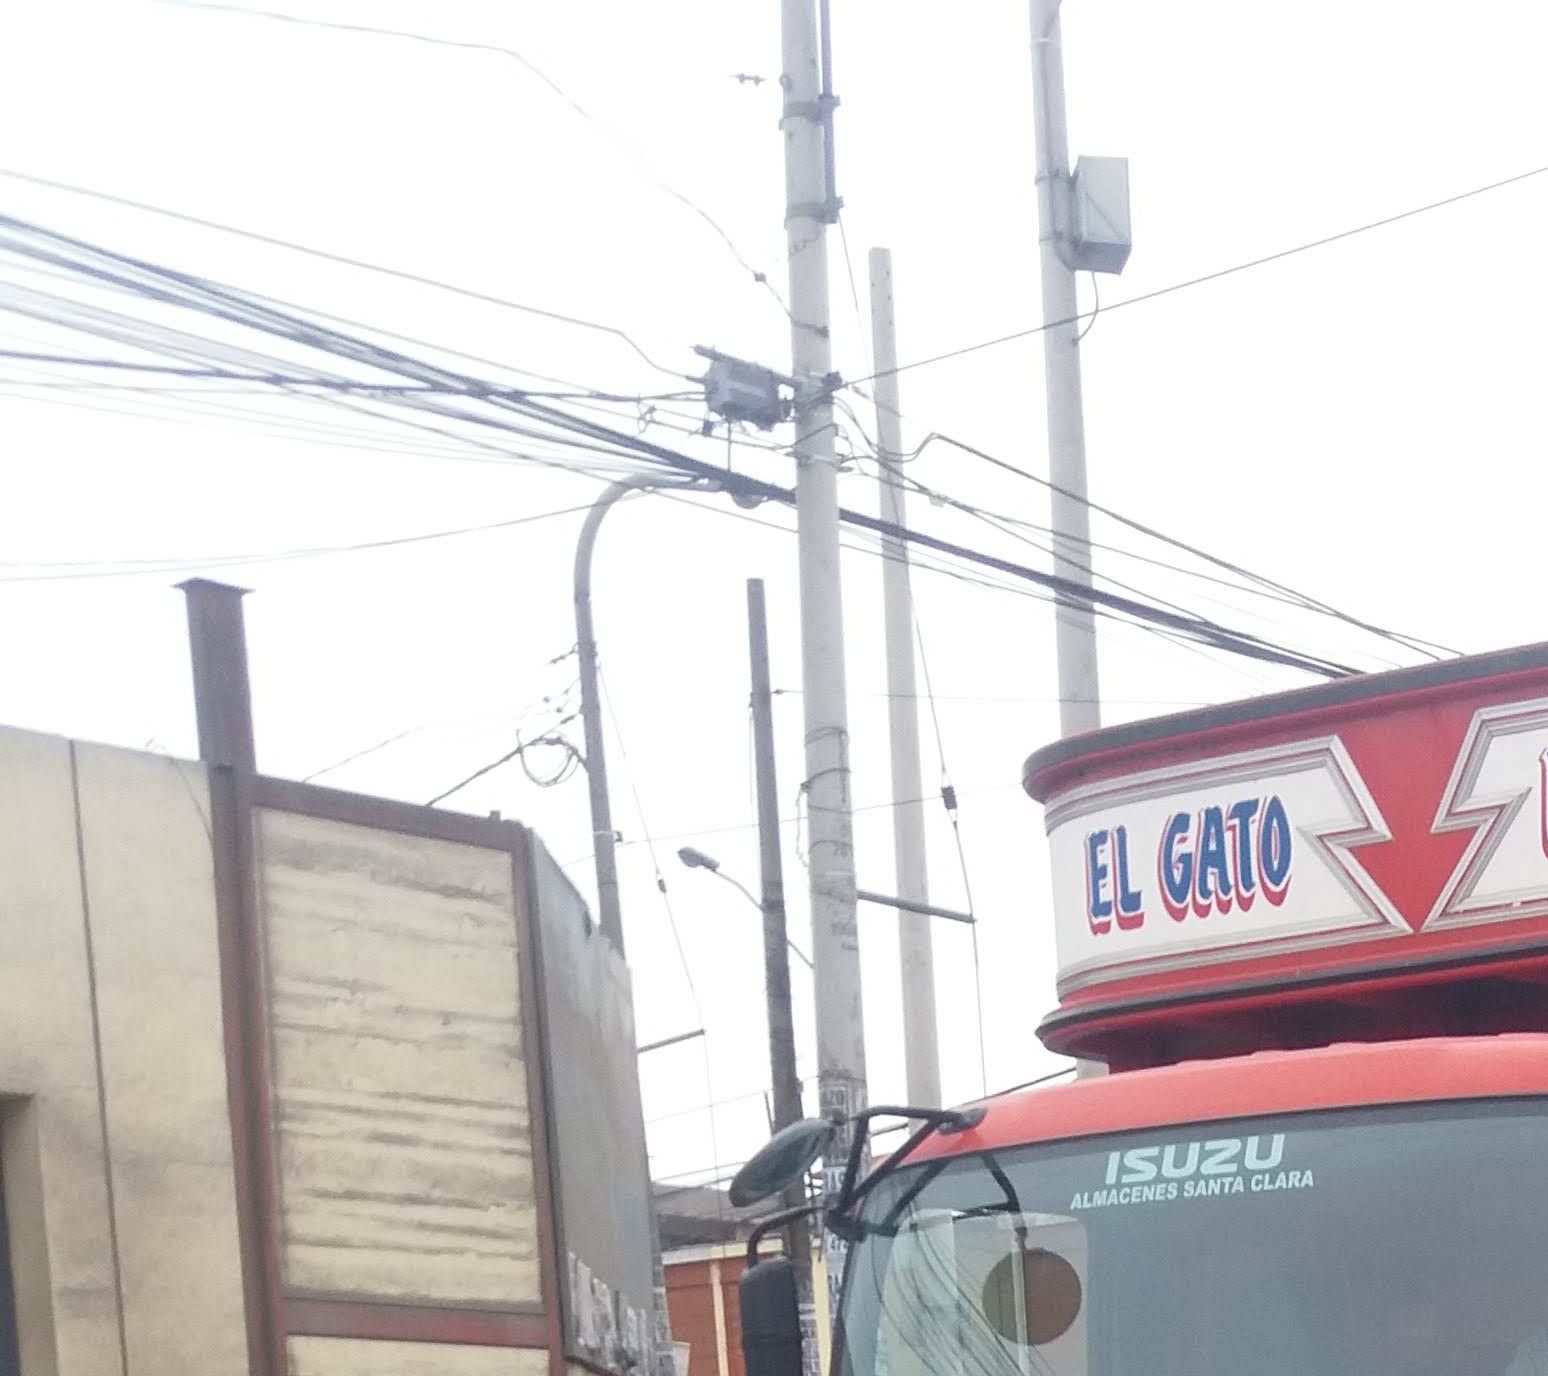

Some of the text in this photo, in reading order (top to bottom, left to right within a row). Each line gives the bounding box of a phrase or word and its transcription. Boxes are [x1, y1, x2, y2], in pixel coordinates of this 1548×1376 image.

[1085, 825, 1145, 935] EL
[1157, 795, 1292, 922] GATO
[1105, 1133, 1286, 1185] ISUZU
[1070, 1169, 1314, 1210] ALMACENES SANTA CLARA
